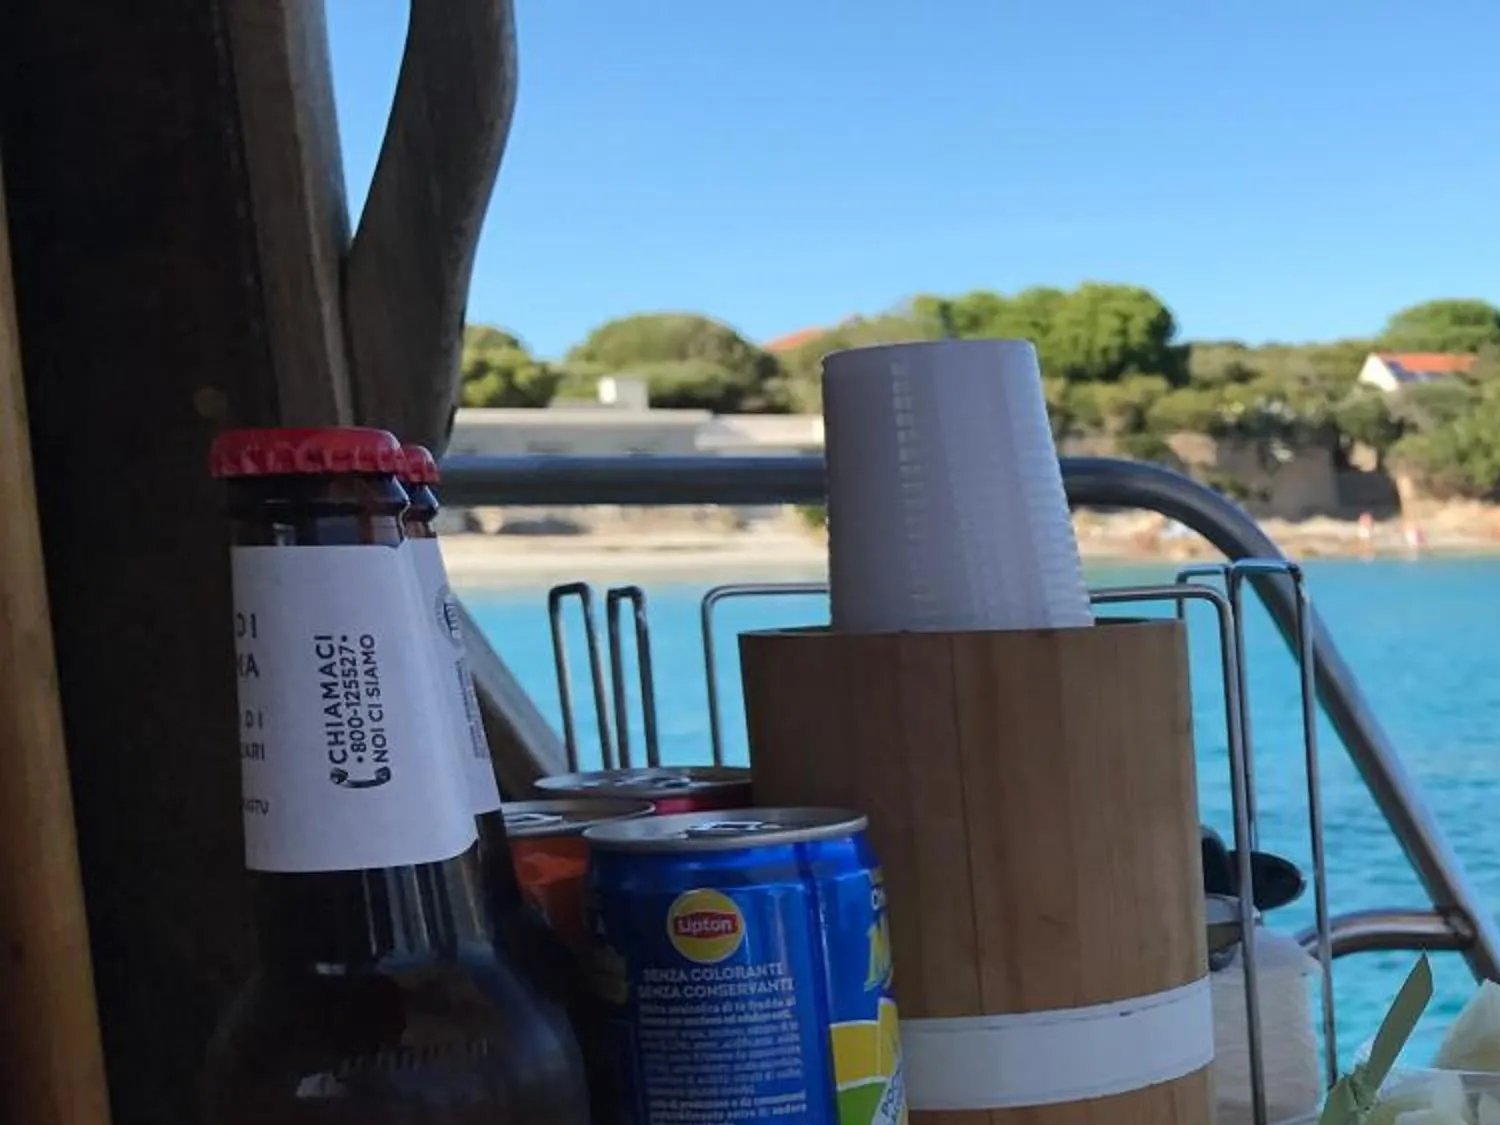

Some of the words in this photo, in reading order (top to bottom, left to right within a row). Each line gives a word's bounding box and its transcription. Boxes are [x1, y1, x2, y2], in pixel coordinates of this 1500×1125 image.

[359, 633, 381, 697] SIAMO
[314, 634, 348, 765] CHIAMACI
[367, 703, 384, 722] CI
[369, 727, 389, 762] NOI
[678, 916, 733, 937] Lipton
